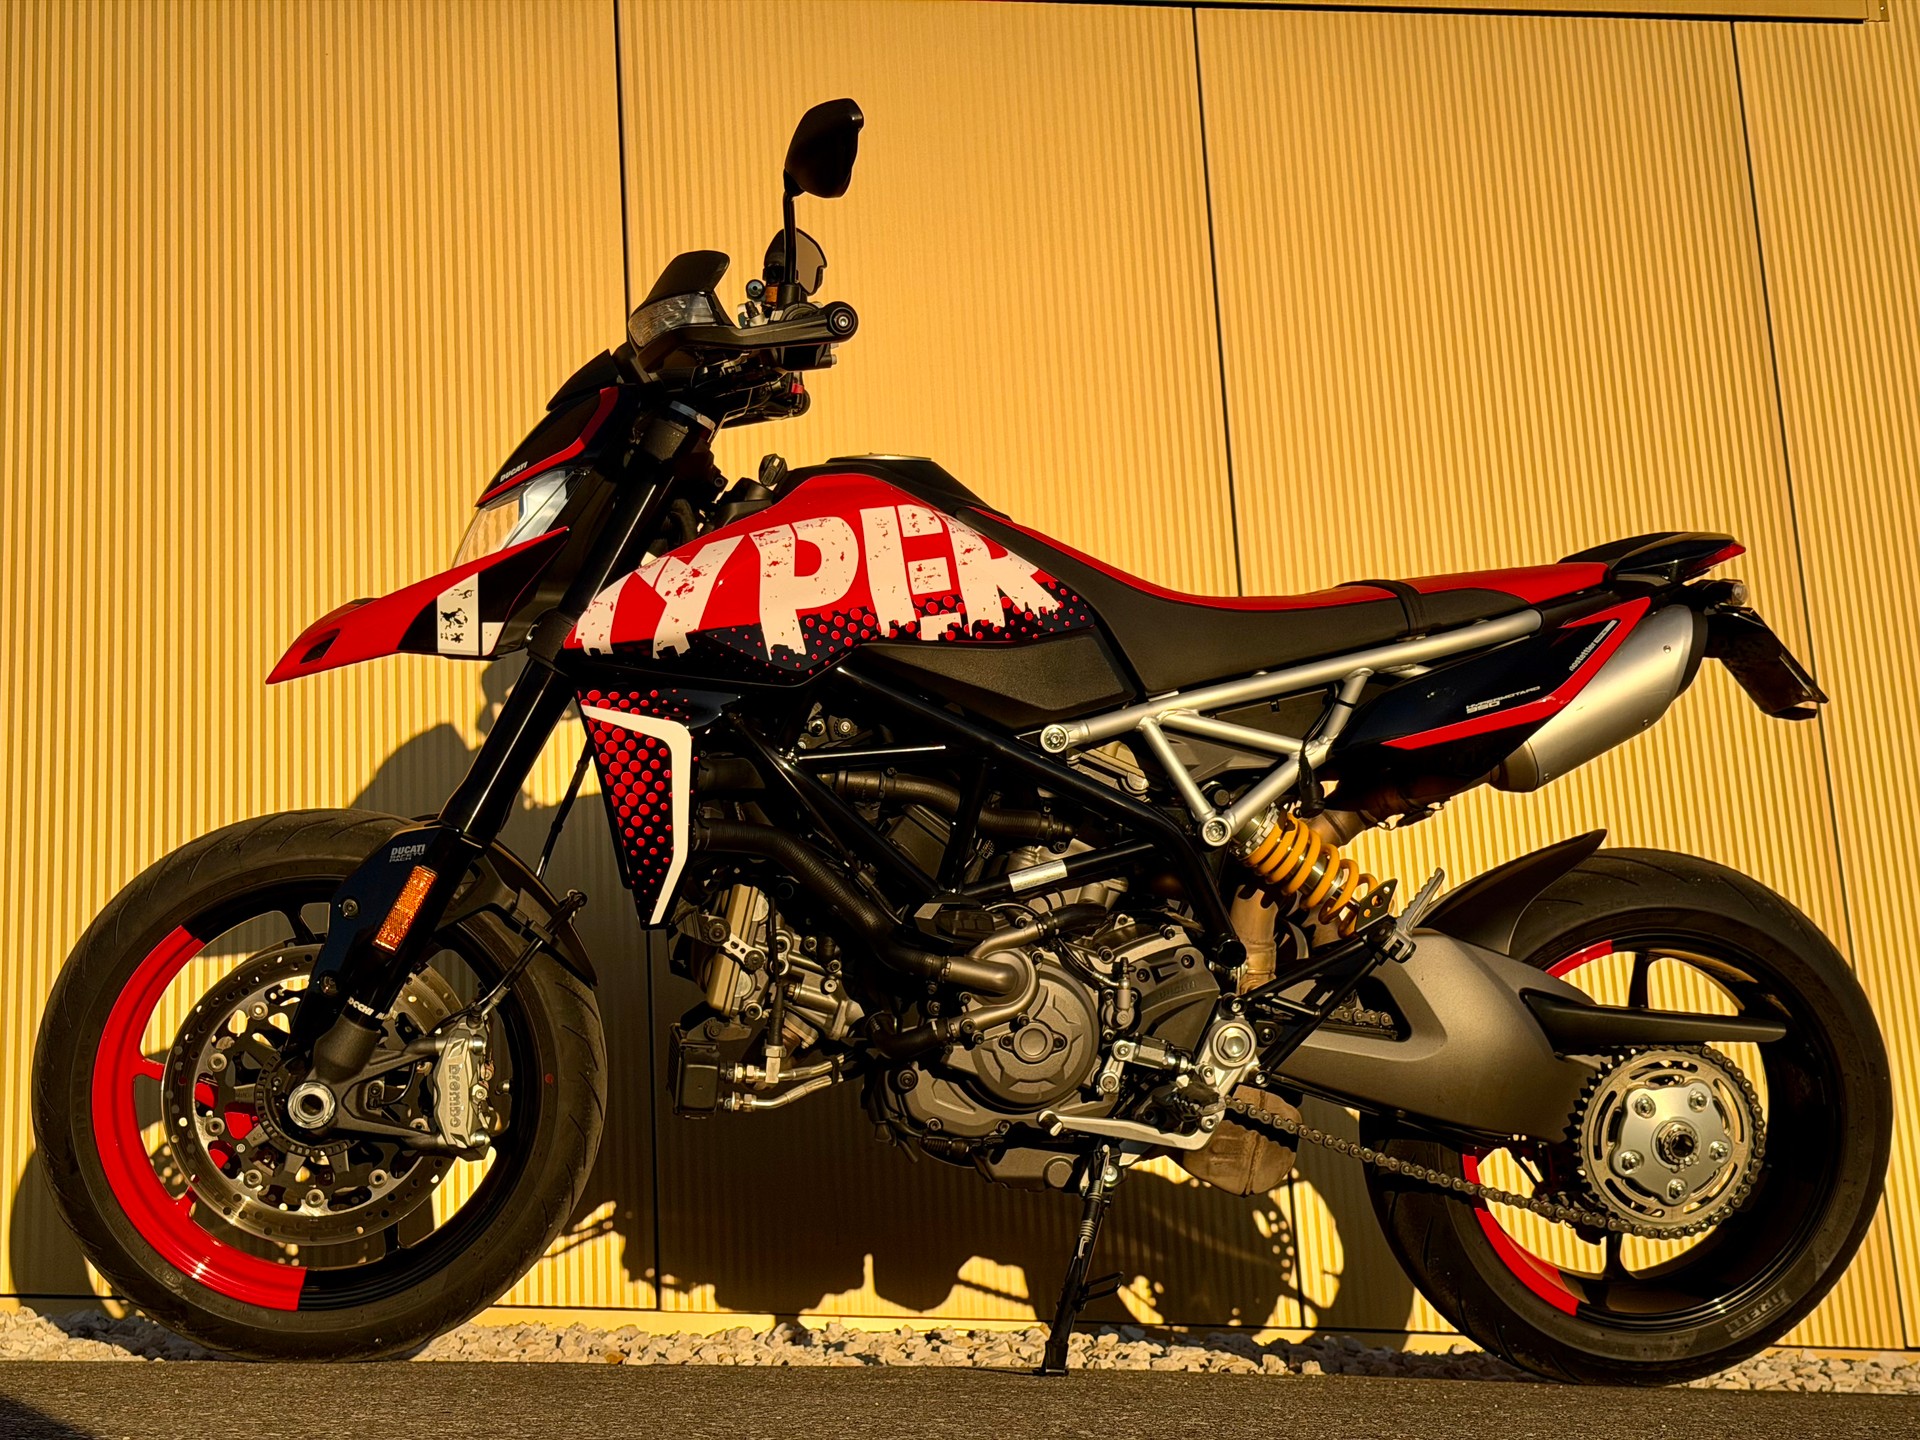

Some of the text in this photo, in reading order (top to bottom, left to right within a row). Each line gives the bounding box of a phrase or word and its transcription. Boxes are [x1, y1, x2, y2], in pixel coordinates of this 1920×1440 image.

[500, 461, 528, 482] DUCATI
[390, 844, 426, 856] DUCATI
[348, 996, 375, 1016] OCCHI
[448, 1064, 462, 1128] brembo
[1724, 1288, 1792, 1337] PIRELLI
